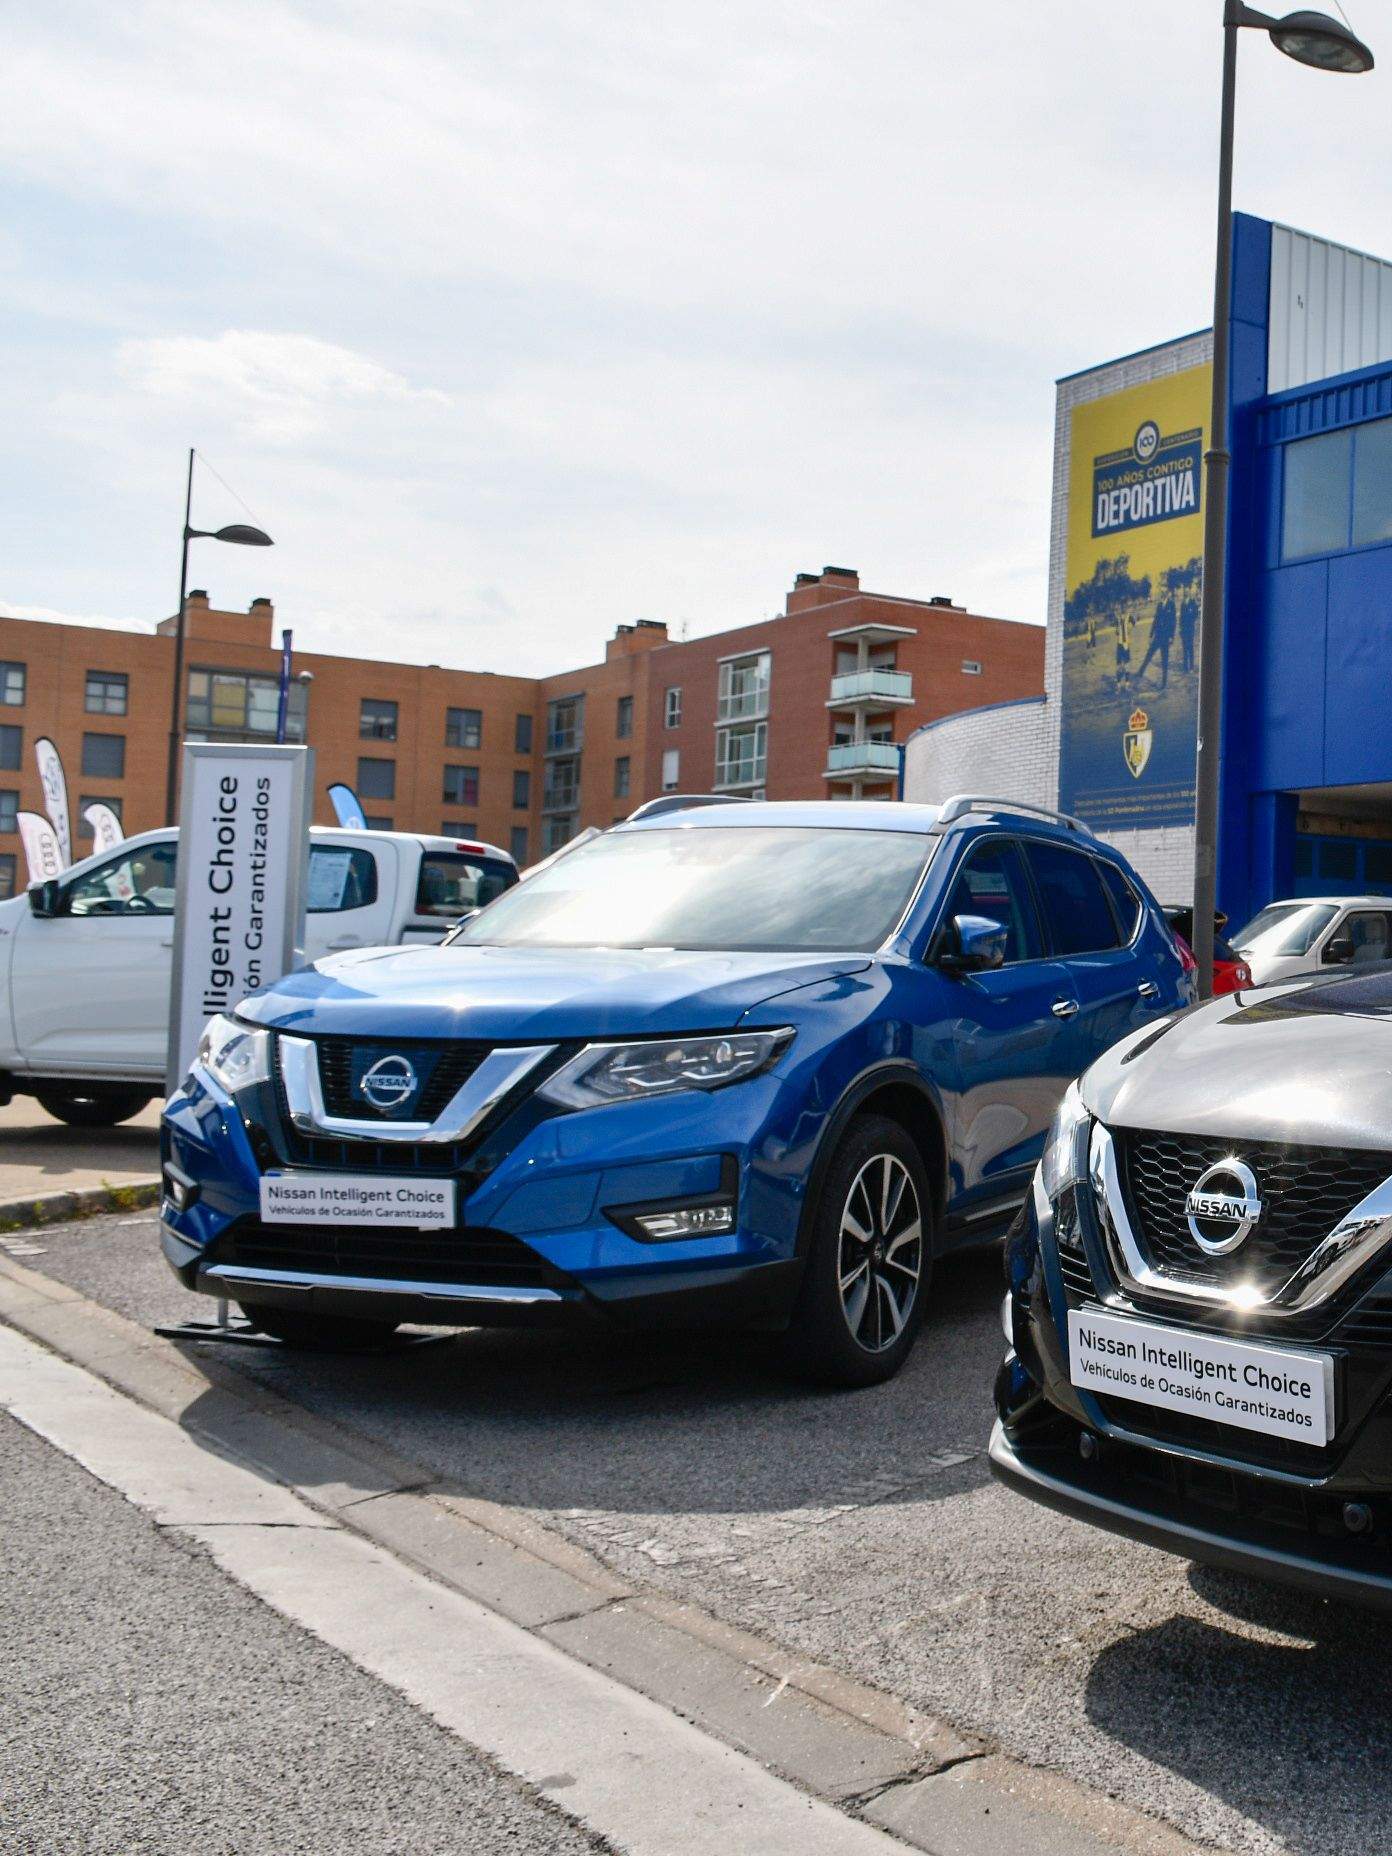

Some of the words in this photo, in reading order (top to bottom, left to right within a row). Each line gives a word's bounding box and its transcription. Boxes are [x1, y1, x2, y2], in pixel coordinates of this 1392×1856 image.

[1098, 480, 1114, 492] 100
[1117, 469, 1145, 486] AÑOS
[1147, 456, 1194, 477] CONTIGO
[1096, 470, 1195, 529] DEPORTIVA
[208, 776, 238, 894] Choice
[245, 776, 271, 950] Garantizados
[364, 1077, 412, 1088] NISSAN
[268, 1186, 316, 1200] Nissan
[320, 1187, 392, 1203] Intelligent
[396, 1188, 445, 1203] Choice
[317, 1206, 331, 1217] de
[332, 1206, 373, 1218] Ocasión
[375, 1207, 446, 1220] Garantizados
[1185, 1197, 1248, 1219] NISSAN
[1079, 1327, 1138, 1361] Nissan
[1142, 1342, 1238, 1384] Intelligent
[1243, 1364, 1313, 1400] Choice
[1080, 1357, 1138, 1386] Vehículos
[1140, 1374, 1156, 1390] de
[1158, 1377, 1212, 1404] Ocasión
[1213, 1391, 1314, 1428] Garantizados
